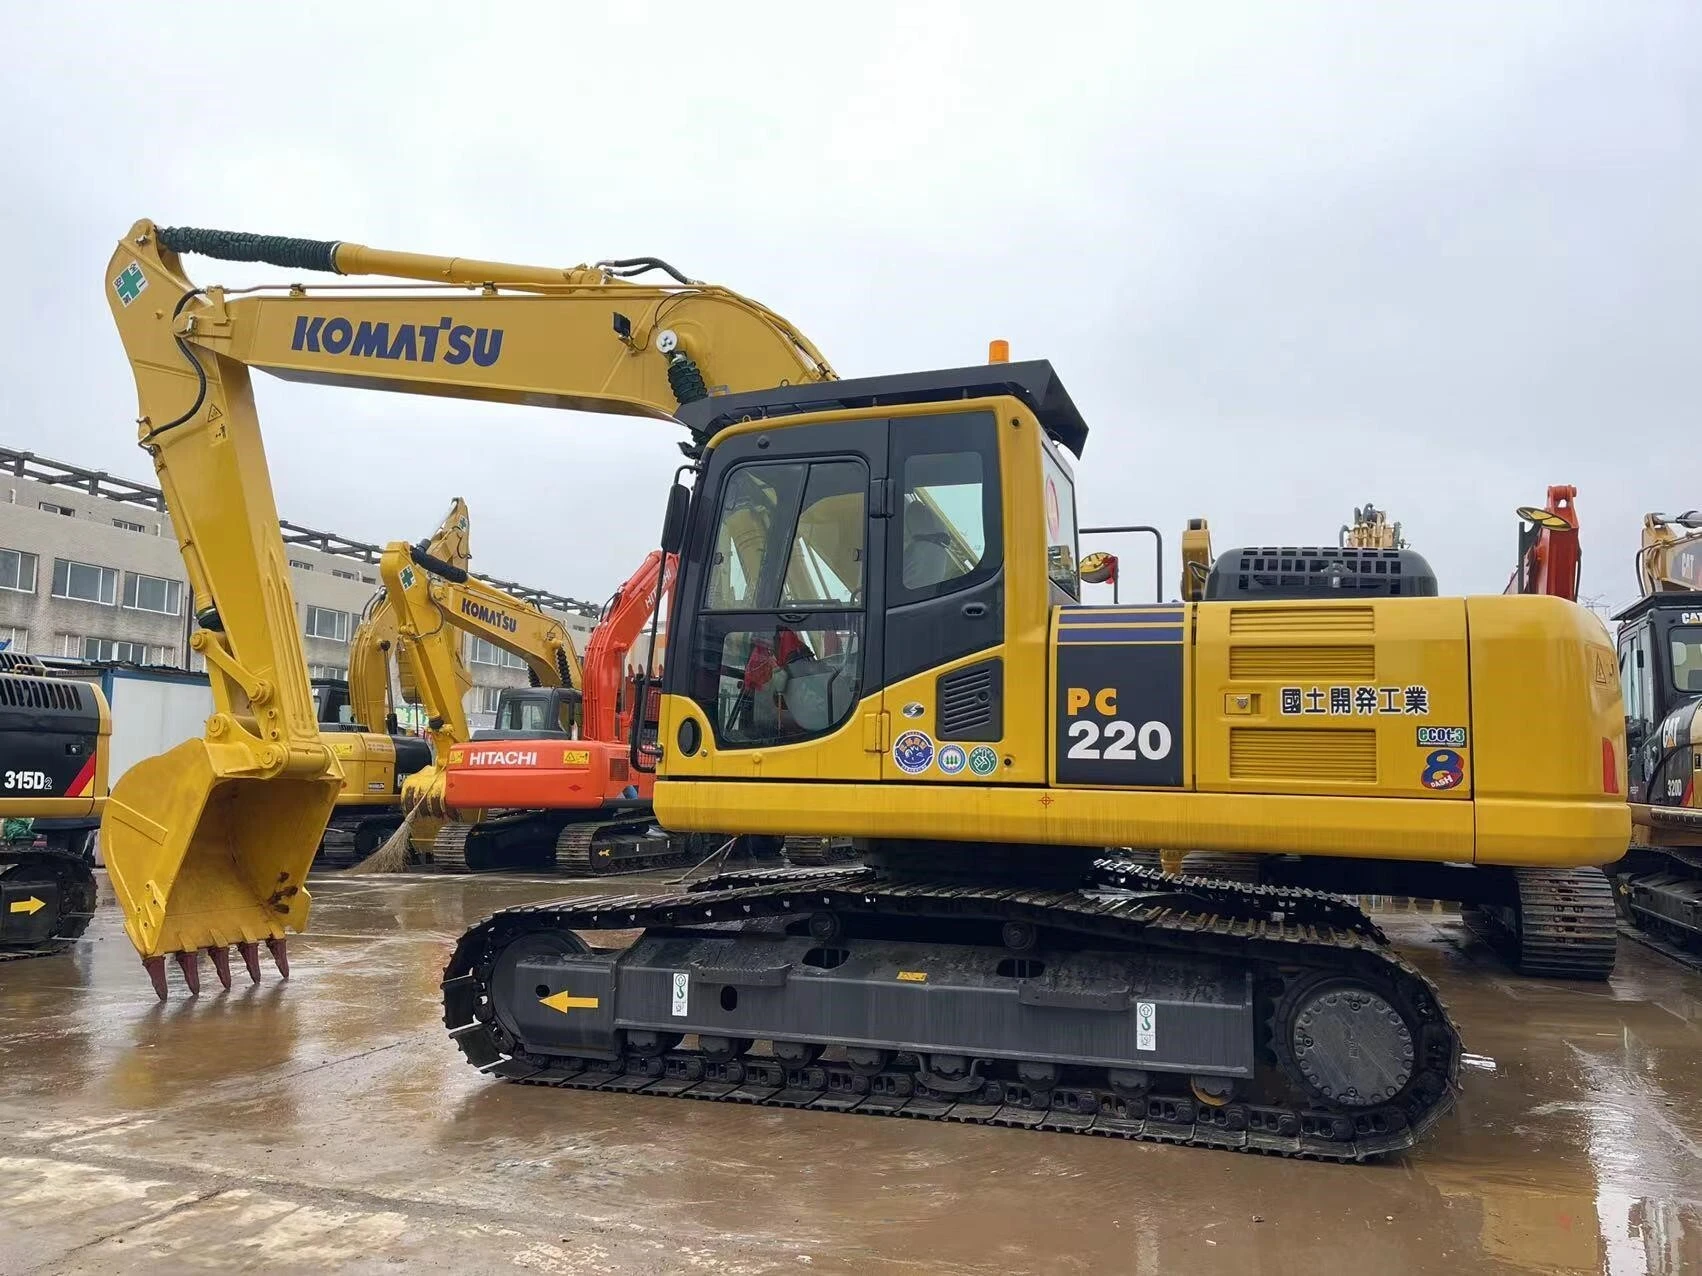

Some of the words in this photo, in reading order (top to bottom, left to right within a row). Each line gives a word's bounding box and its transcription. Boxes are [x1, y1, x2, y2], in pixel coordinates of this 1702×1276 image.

[292, 316, 503, 366] KOMATSU
[462, 598, 516, 632] KOMATSU
[1067, 688, 1116, 716] PC
[1281, 686, 1430, 715] 國土開発工業
[1067, 720, 1172, 760] 220
[469, 751, 537, 768] HITACHI
[1421, 749, 1464, 790] 8
[4, 770, 53, 789] 315D2
[1430, 774, 1454, 788] DASH
